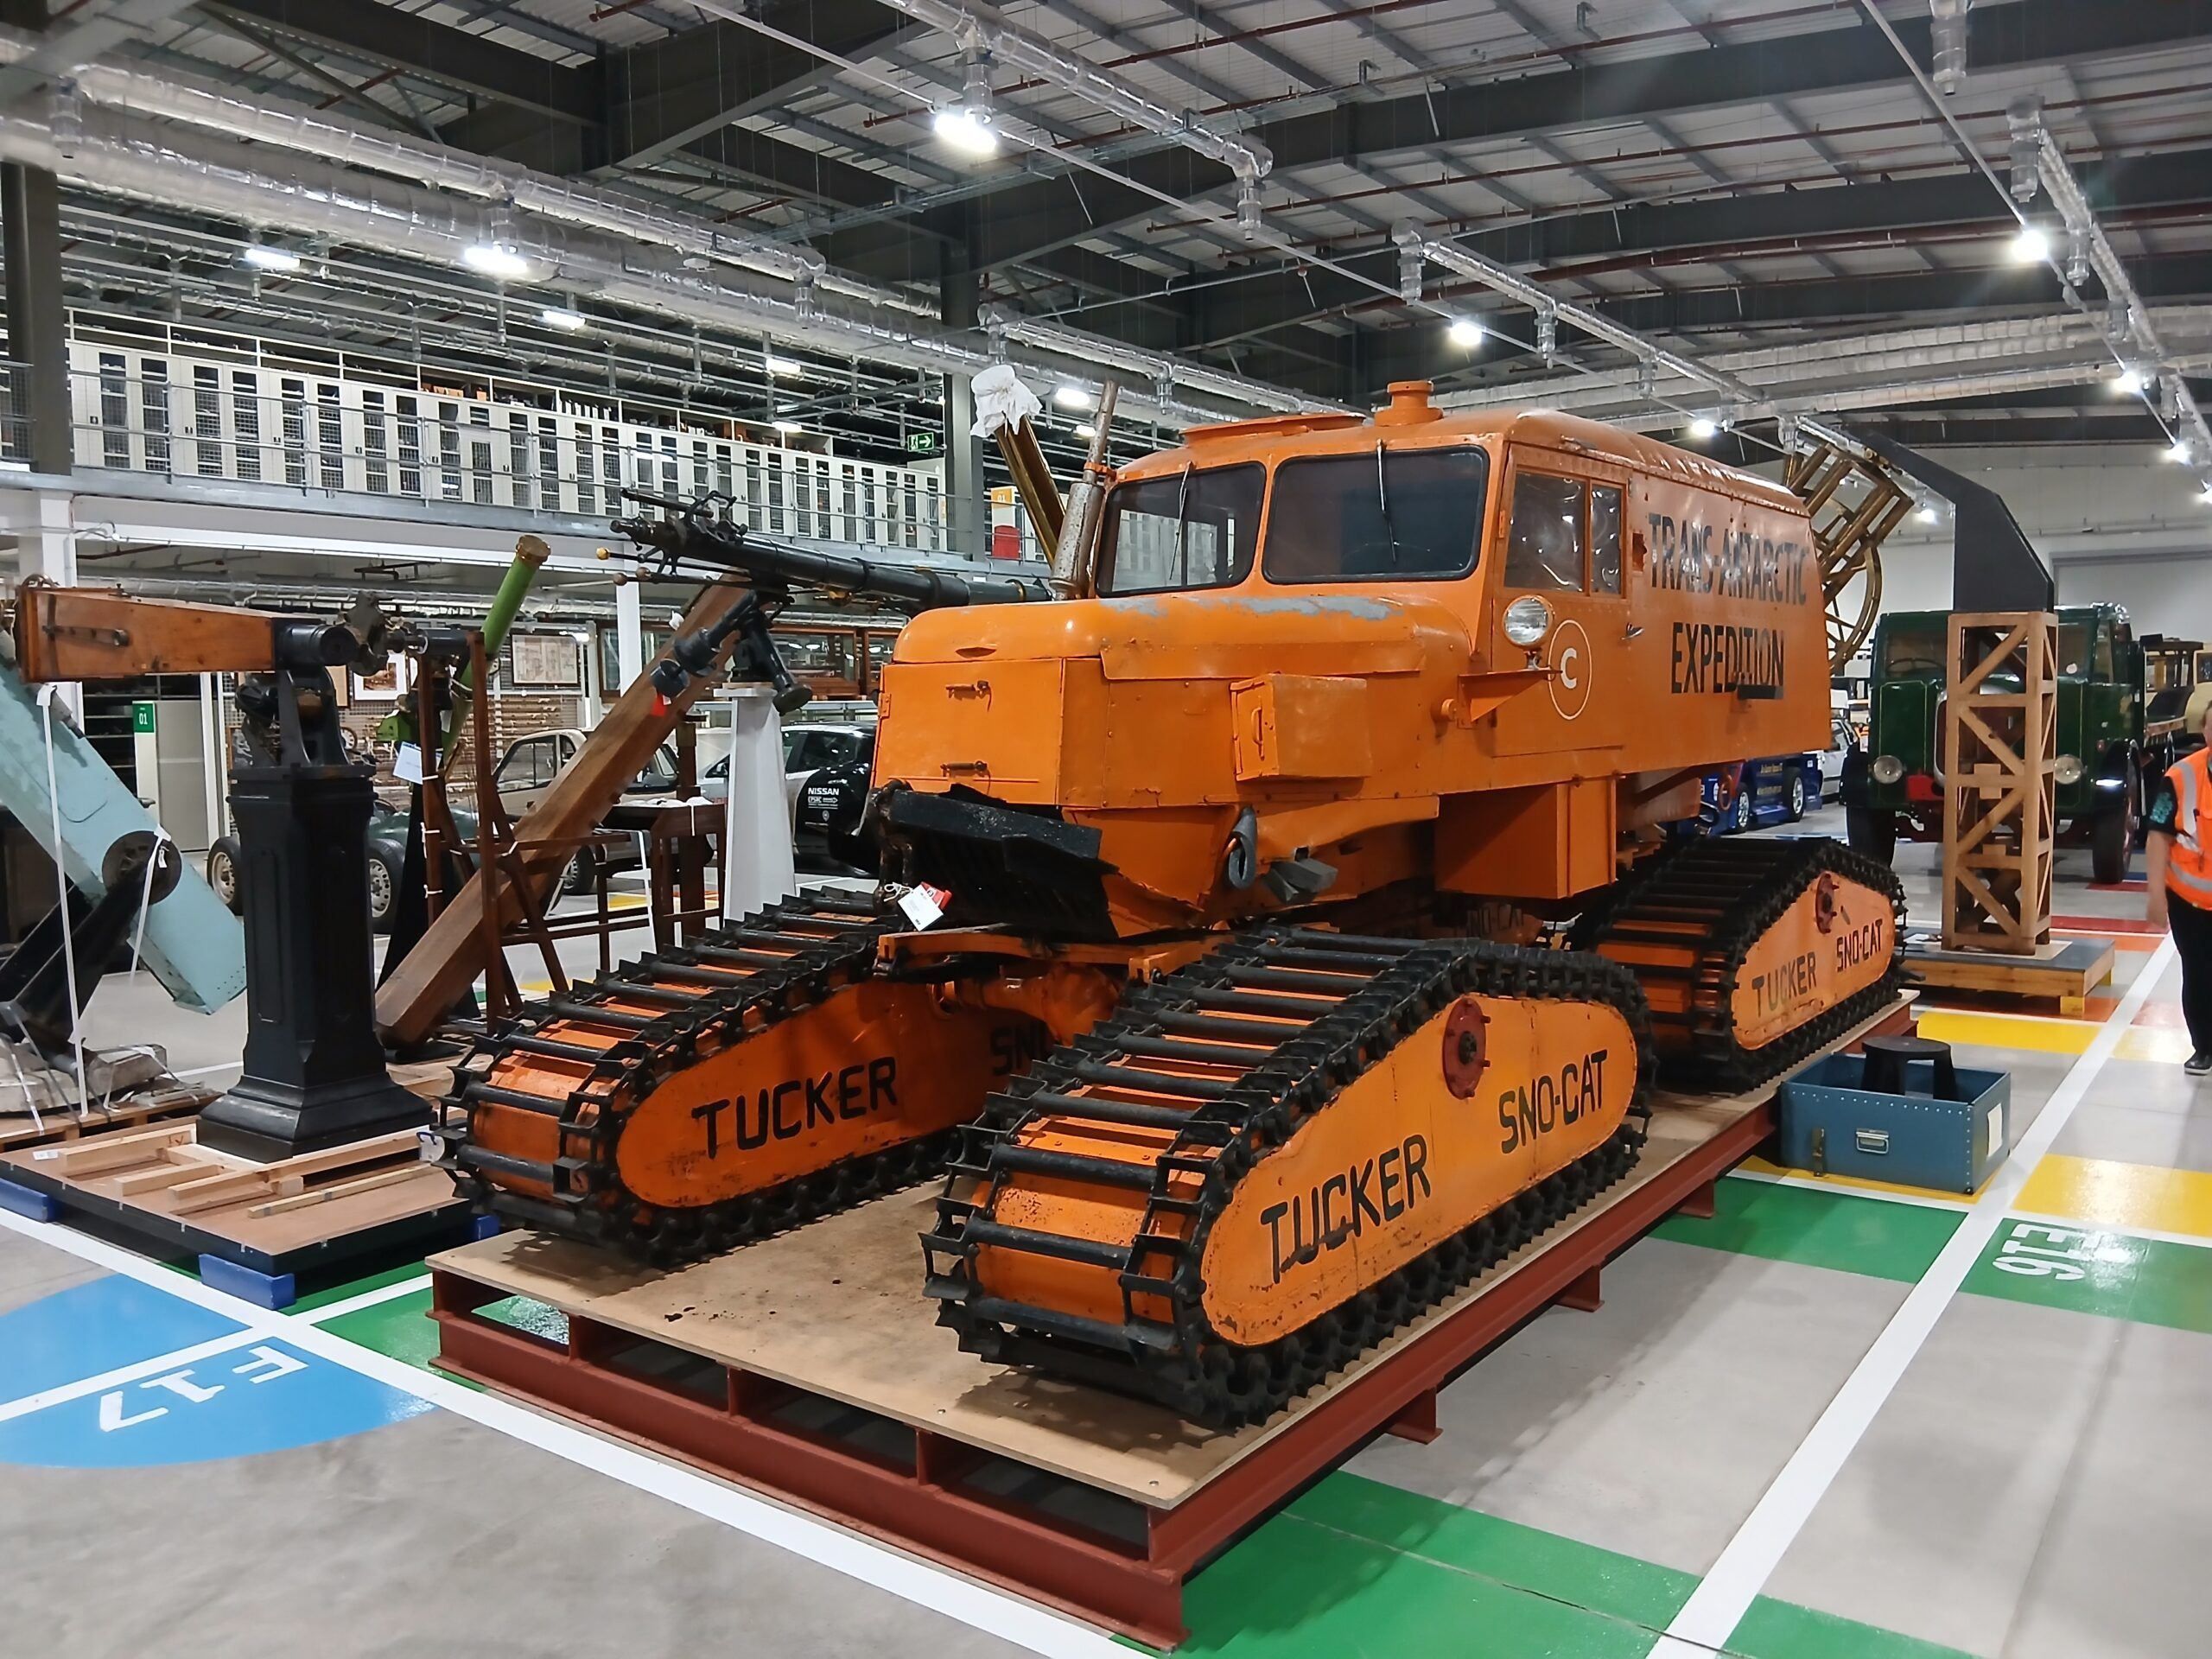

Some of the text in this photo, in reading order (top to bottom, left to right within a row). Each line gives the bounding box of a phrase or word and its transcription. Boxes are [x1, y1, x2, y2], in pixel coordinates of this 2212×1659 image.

[1649, 512, 1809, 605] TRANS-ANTARCTIC
[1560, 647, 1578, 690] C
[1671, 621, 1784, 694] EXPEDITION
[138, 712, 149, 725] 01
[808, 787, 840, 796] NISSAN
[1751, 951, 1817, 1019] TUCKER
[691, 1056, 898, 1160] TUCKER
[1260, 1049, 1608, 1285] TUCKER SNO-CAT
[99, 1345, 310, 1433] E17
